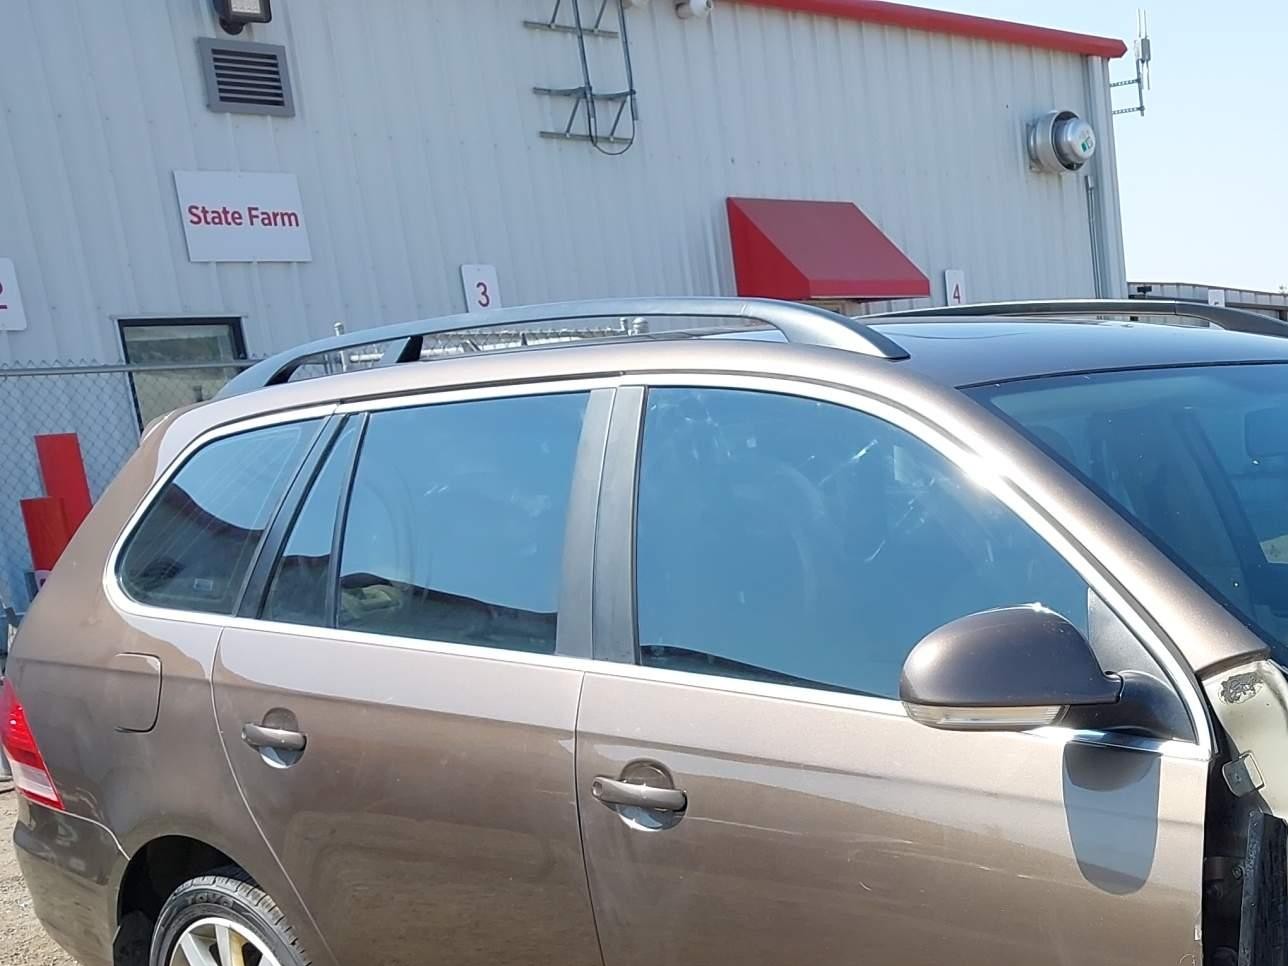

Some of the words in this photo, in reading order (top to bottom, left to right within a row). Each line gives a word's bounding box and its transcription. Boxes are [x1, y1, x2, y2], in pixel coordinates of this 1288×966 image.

[187, 204, 243, 226] State
[247, 206, 300, 228] Farm
[475, 281, 490, 308] 3
[952, 282, 961, 304] 4
[184, 891, 234, 909] TOYO
